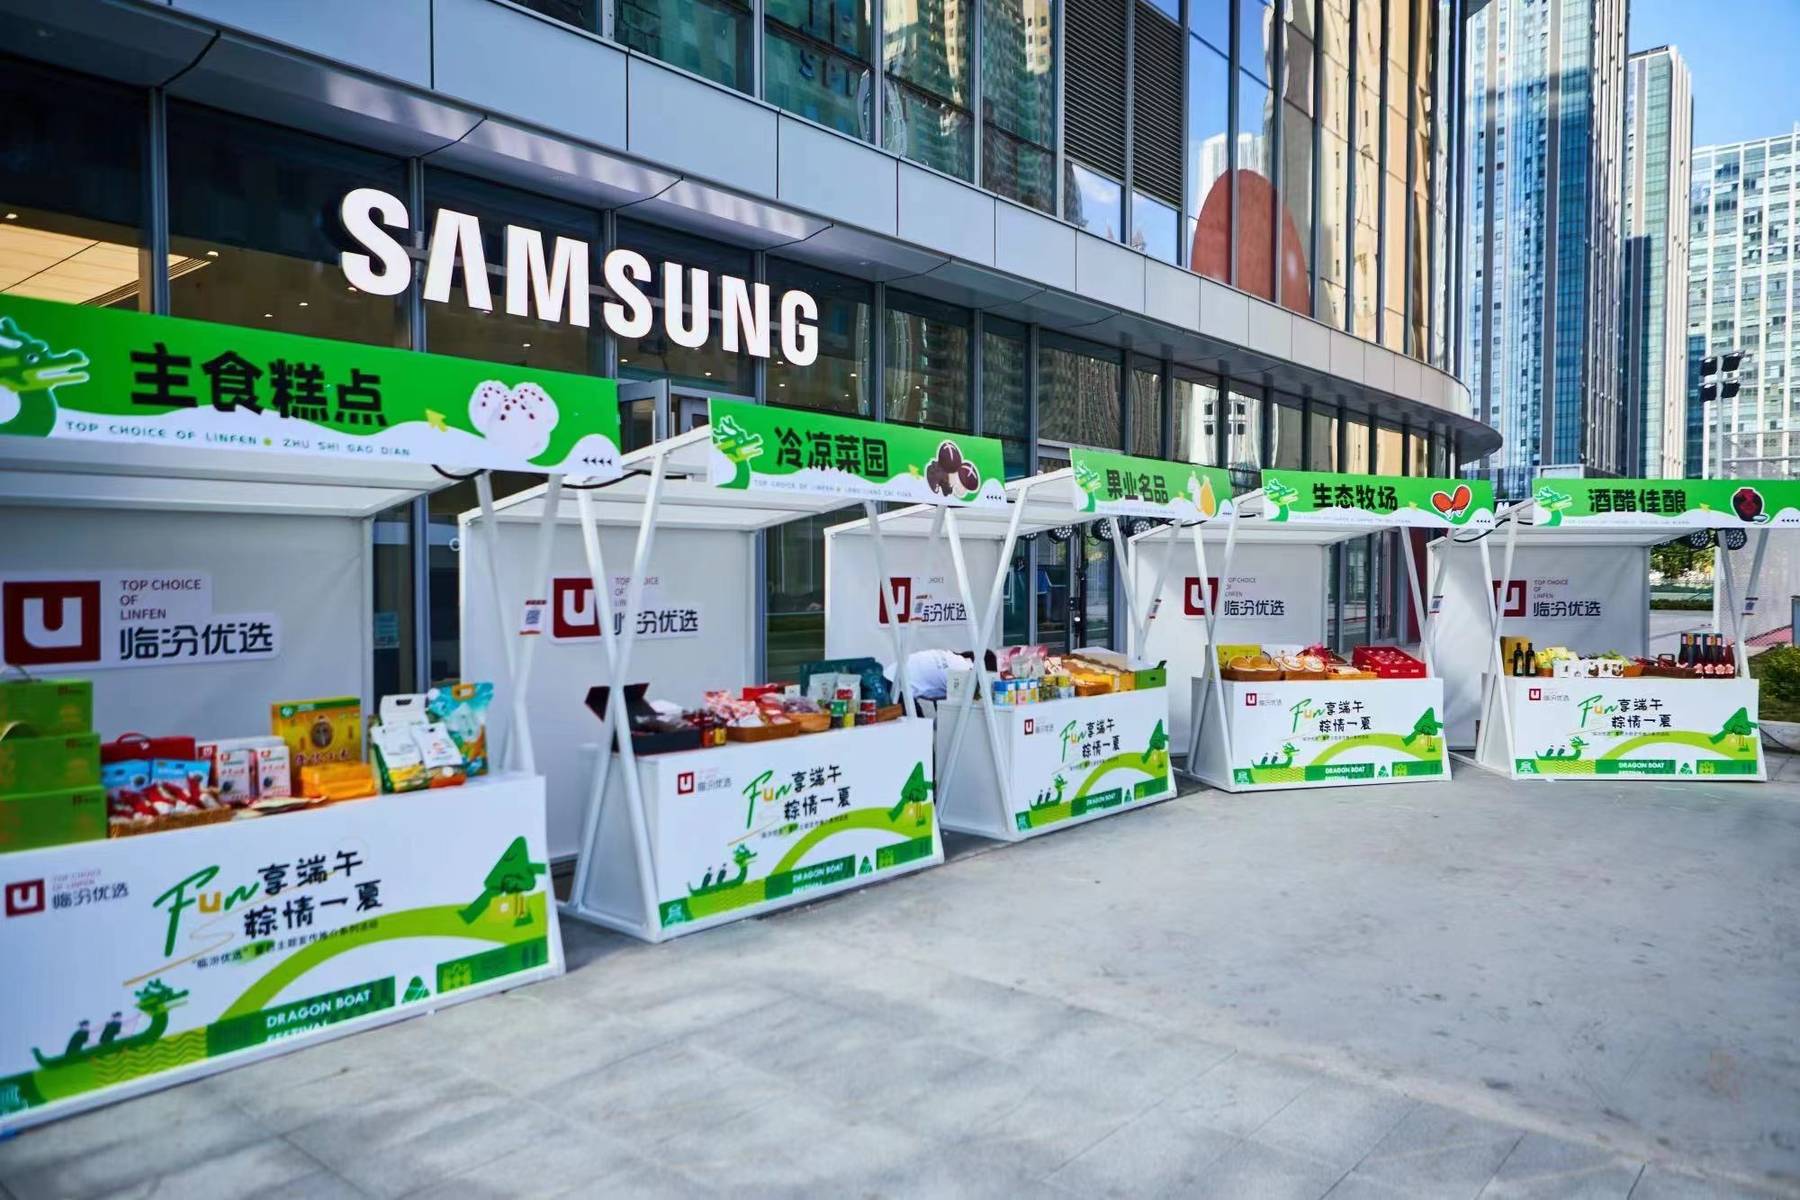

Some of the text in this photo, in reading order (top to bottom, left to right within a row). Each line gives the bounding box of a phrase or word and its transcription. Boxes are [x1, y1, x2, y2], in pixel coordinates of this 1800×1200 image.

[340, 187, 820, 367] SAMSUNG
[130, 342, 389, 427] 主食糕点
[66, 420, 99, 433] TOP
[109, 424, 169, 439] CHOICE
[176, 430, 197, 440] OF
[205, 431, 258, 446] LINFEN
[283, 438, 310, 450] ZHU
[774, 426, 889, 478] 冷凉菜园
[1106, 468, 1169, 504] 果业名品
[1312, 483, 1399, 511] 生态牧场
[1588, 488, 1687, 513] 酒醋佳酿
[121, 578, 202, 591] TOP CHOICE
[120, 595, 139, 606] OF
[1224, 600, 1285, 616] 临汾优选
[1533, 600, 1601, 617] 临汾优选
[120, 608, 167, 621] LINFEN
[120, 622, 273, 661] 临汾优选
[1325, 700, 1365, 715] 享端午
[1617, 698, 1664, 712] 享端午
[1085, 718, 1115, 739] 享端午
[1319, 715, 1372, 734] 粽情一夏
[1611, 713, 1672, 729] 粽情一夏
[1081, 735, 1121, 759] 粽情一夏
[791, 764, 843, 794] 享端午
[784, 787, 851, 821] 粽情一夏
[153, 850, 363, 957] Fun 享端午
[243, 879, 384, 940] 粽情一夏
[266, 989, 371, 1028] DRAGON BOAT
